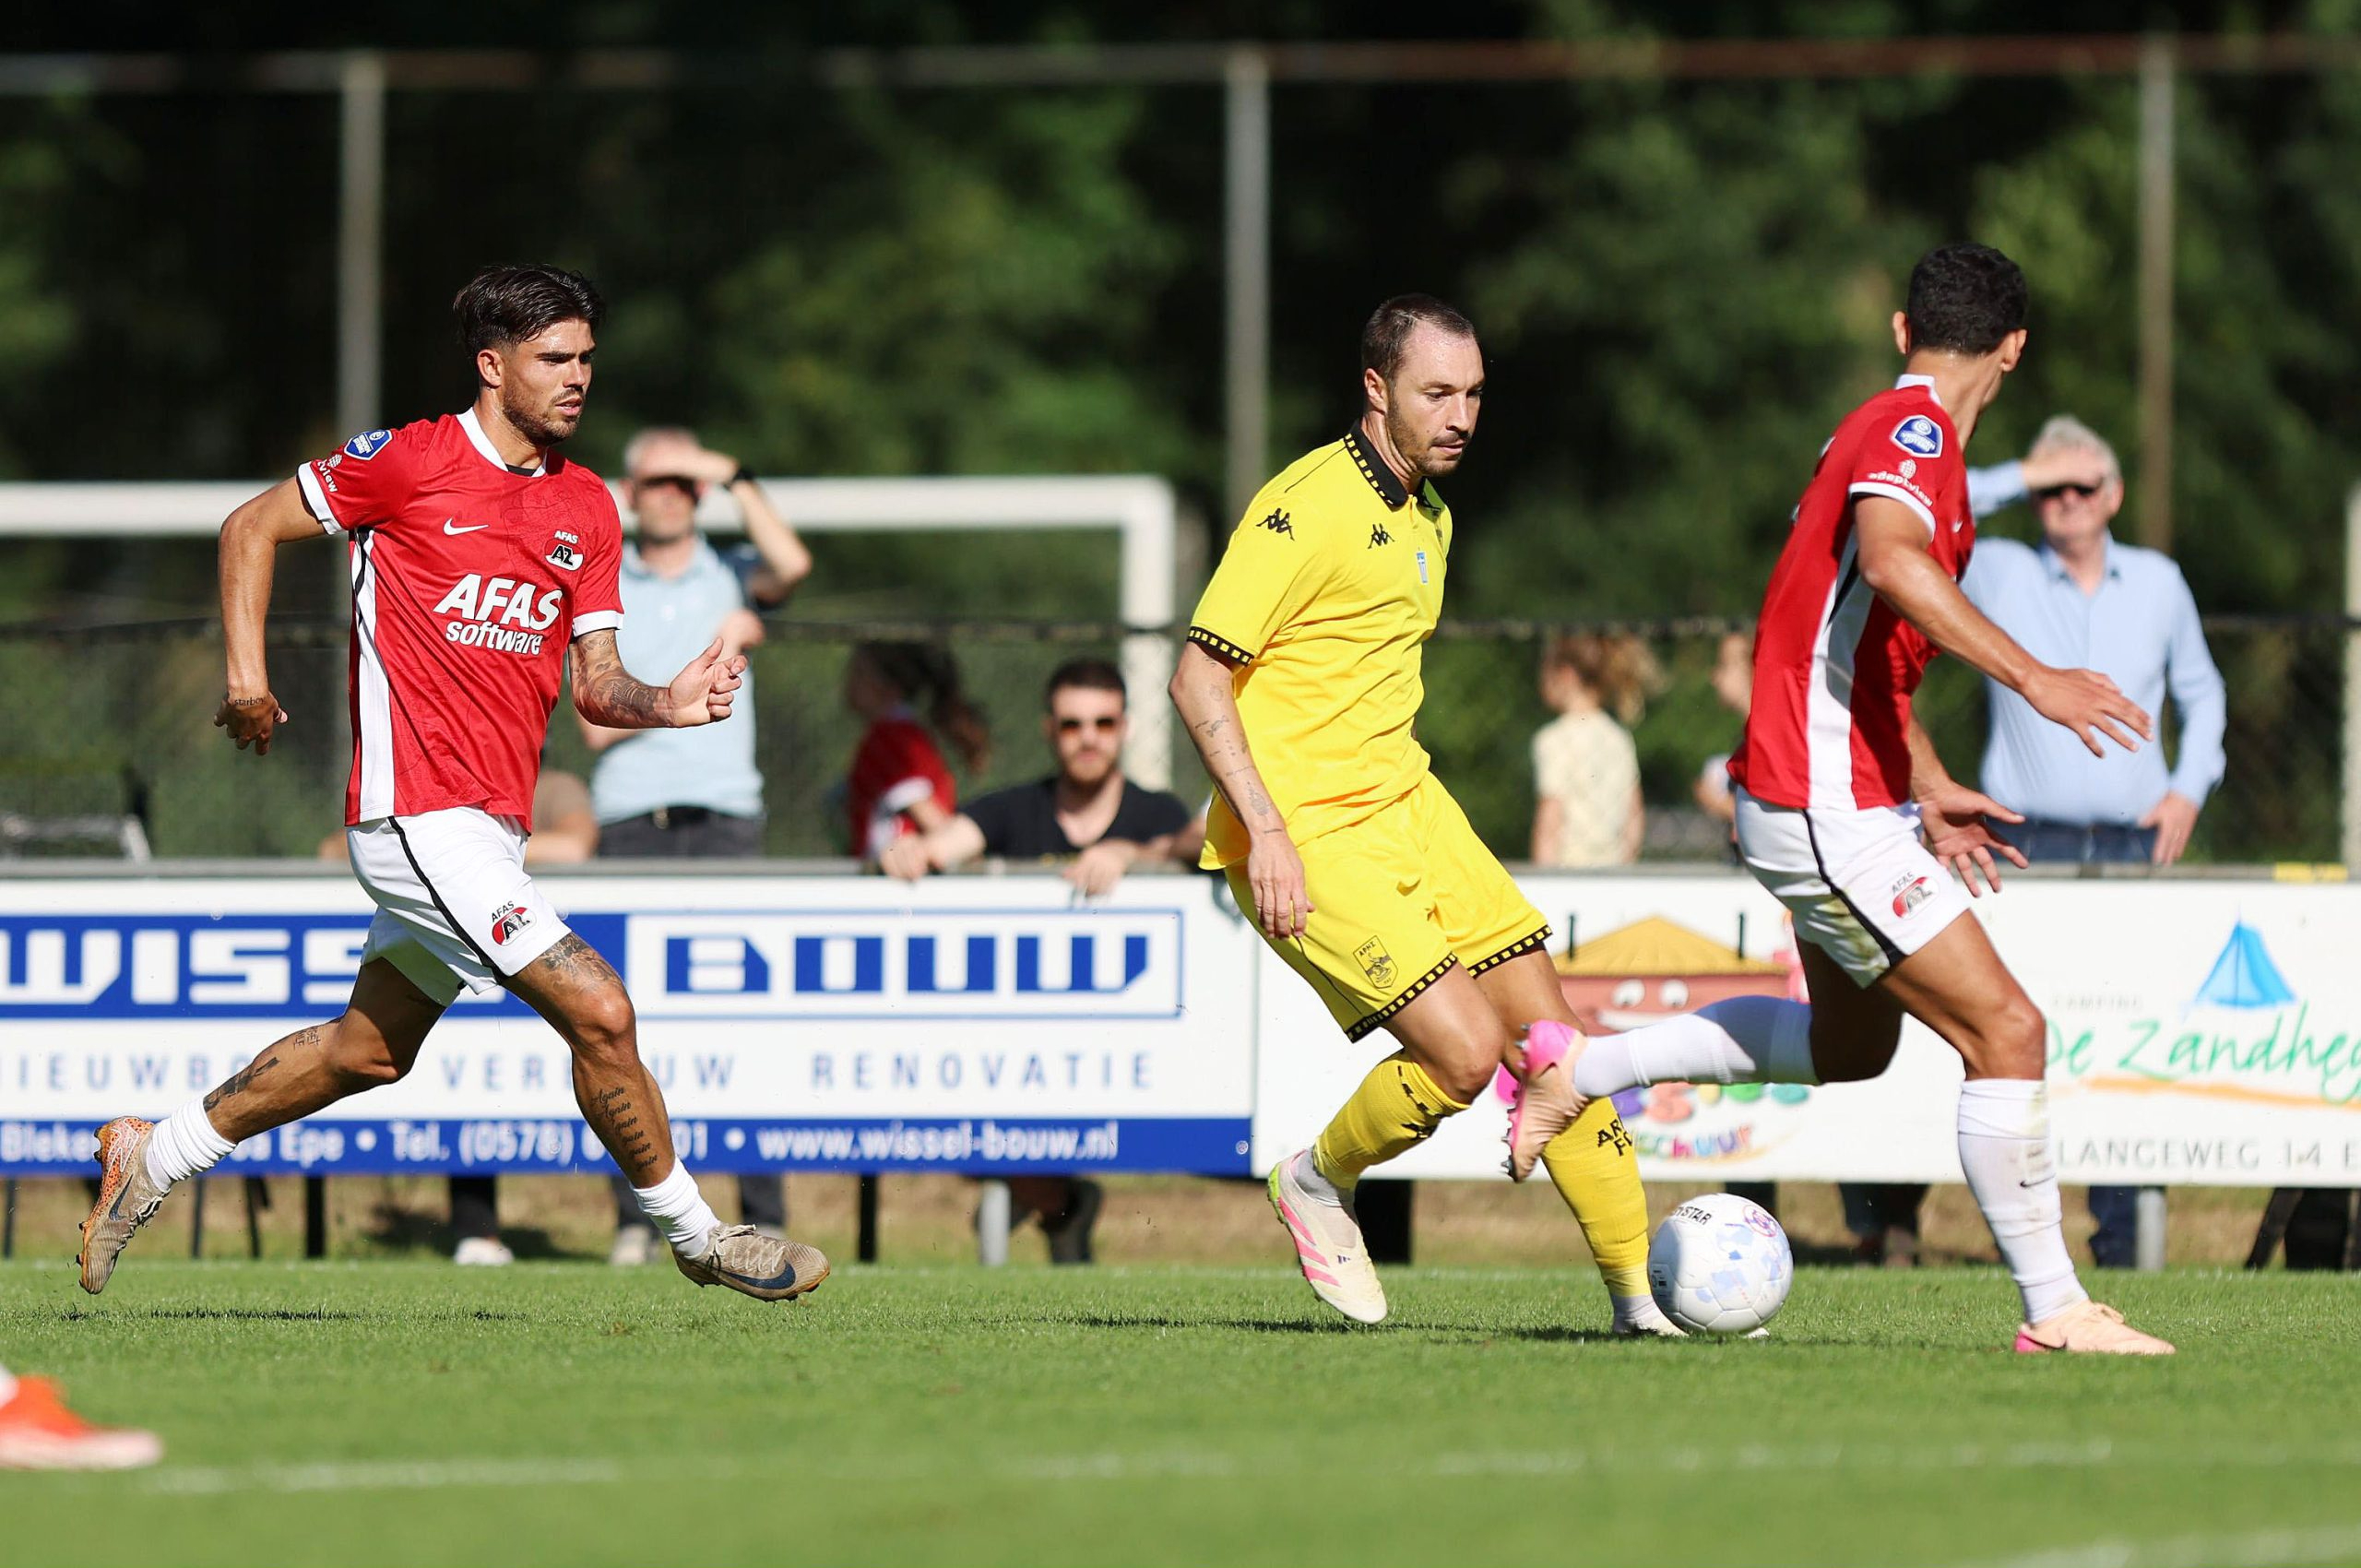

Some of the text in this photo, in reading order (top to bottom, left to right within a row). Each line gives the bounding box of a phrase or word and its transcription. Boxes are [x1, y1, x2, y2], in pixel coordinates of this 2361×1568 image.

[554, 530, 578, 545] AFAS
[552, 545, 574, 566] AZ
[433, 573, 564, 631] AFAS
[445, 621, 544, 655] software
[491, 900, 515, 922] AFAS
[665, 933, 1149, 994] BOUW
[443, 1052, 735, 1092] VERUW
[812, 1051, 1152, 1089] RENOVATIE
[279, 1123, 344, 1169] Epe
[388, 1120, 450, 1162] Tel.
[756, 1119, 1119, 1162] www.wissel-bouw.nl
[1597, 1118, 1624, 1148] AR
[2058, 1139, 2260, 1169] LANGEWEG
